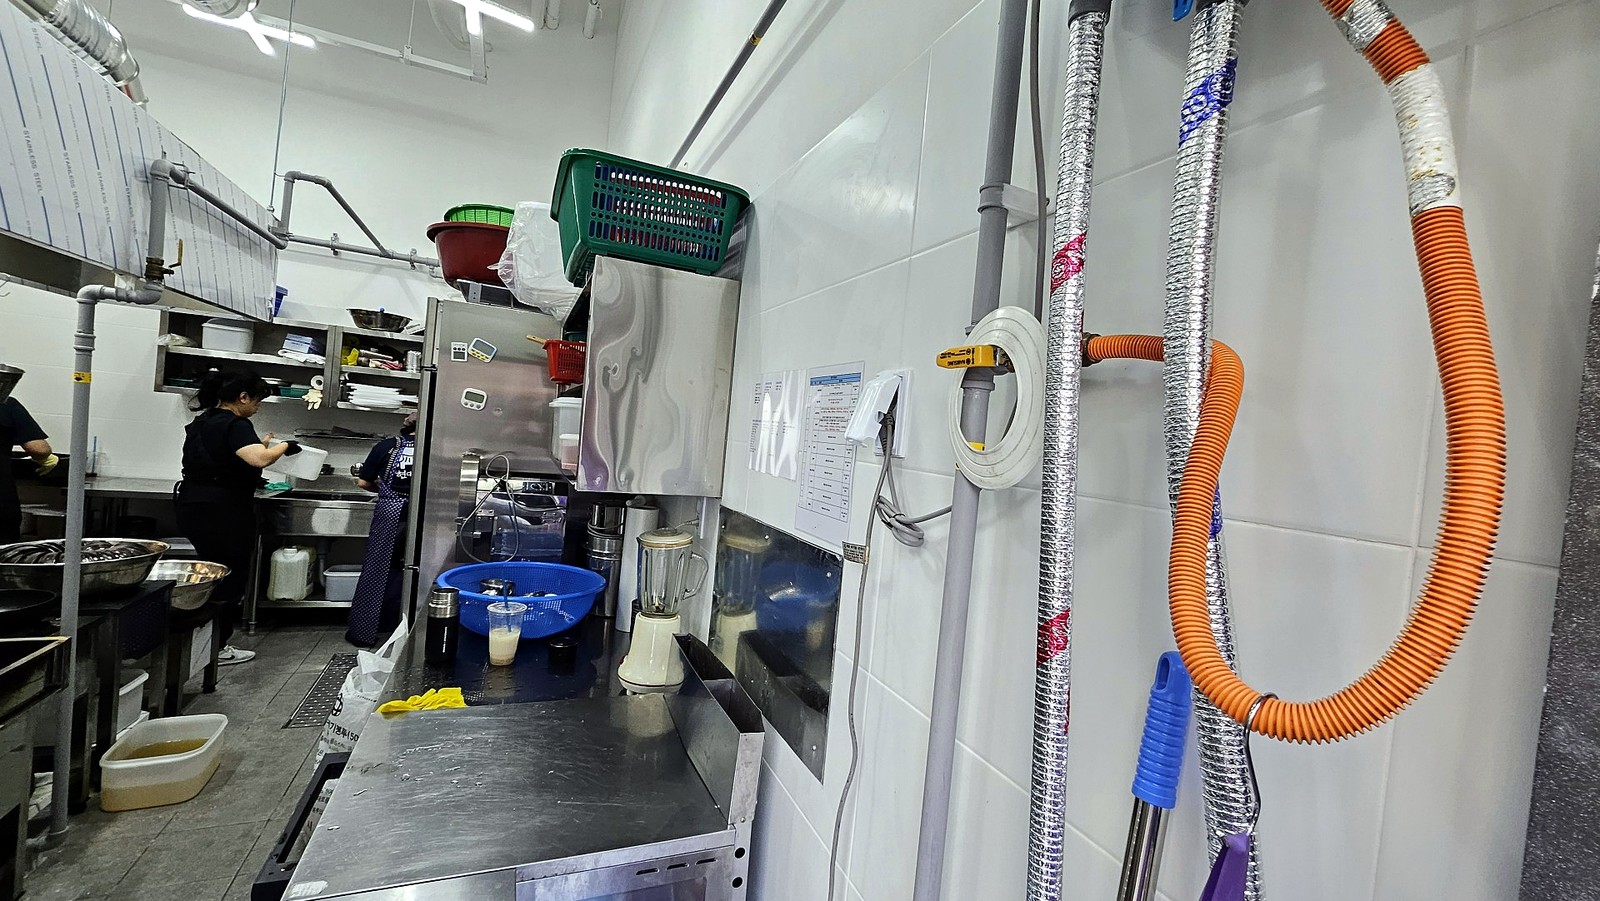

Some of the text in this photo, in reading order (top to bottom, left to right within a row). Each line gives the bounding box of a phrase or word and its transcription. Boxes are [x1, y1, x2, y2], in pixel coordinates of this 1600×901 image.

[23, 129, 37, 169] STAINLESS
[33, 172, 43, 192] STEEL
[63, 152, 76, 189] STAINLESS
[72, 191, 80, 209] STEEL
